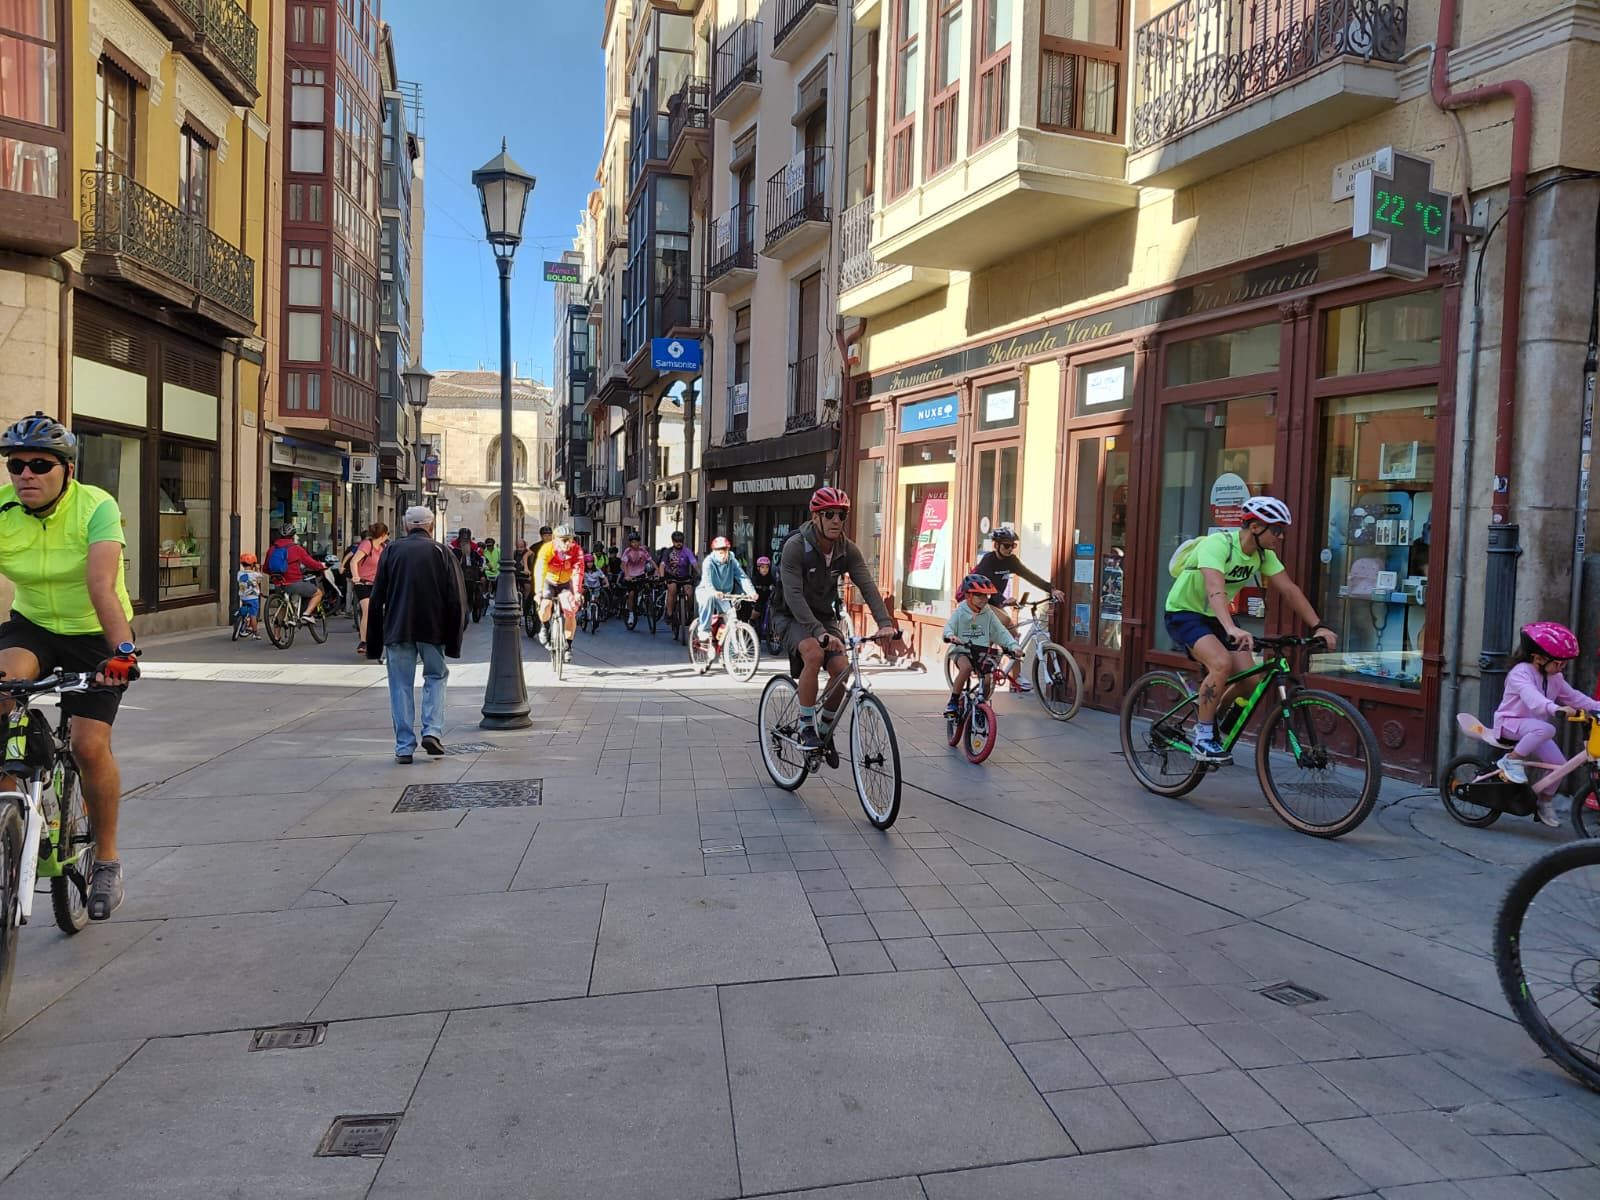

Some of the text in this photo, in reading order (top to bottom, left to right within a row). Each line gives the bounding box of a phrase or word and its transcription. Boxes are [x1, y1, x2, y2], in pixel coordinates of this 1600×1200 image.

[1376, 190, 1405, 226] 22
[546, 273, 577, 283] BOLSOS
[987, 319, 1113, 364] Yolanda Vara
[655, 359, 697, 369] Samsonite
[889, 363, 944, 391] Farmacia
[918, 406, 943, 420] NUXE
[788, 474, 815, 490] WORLD
